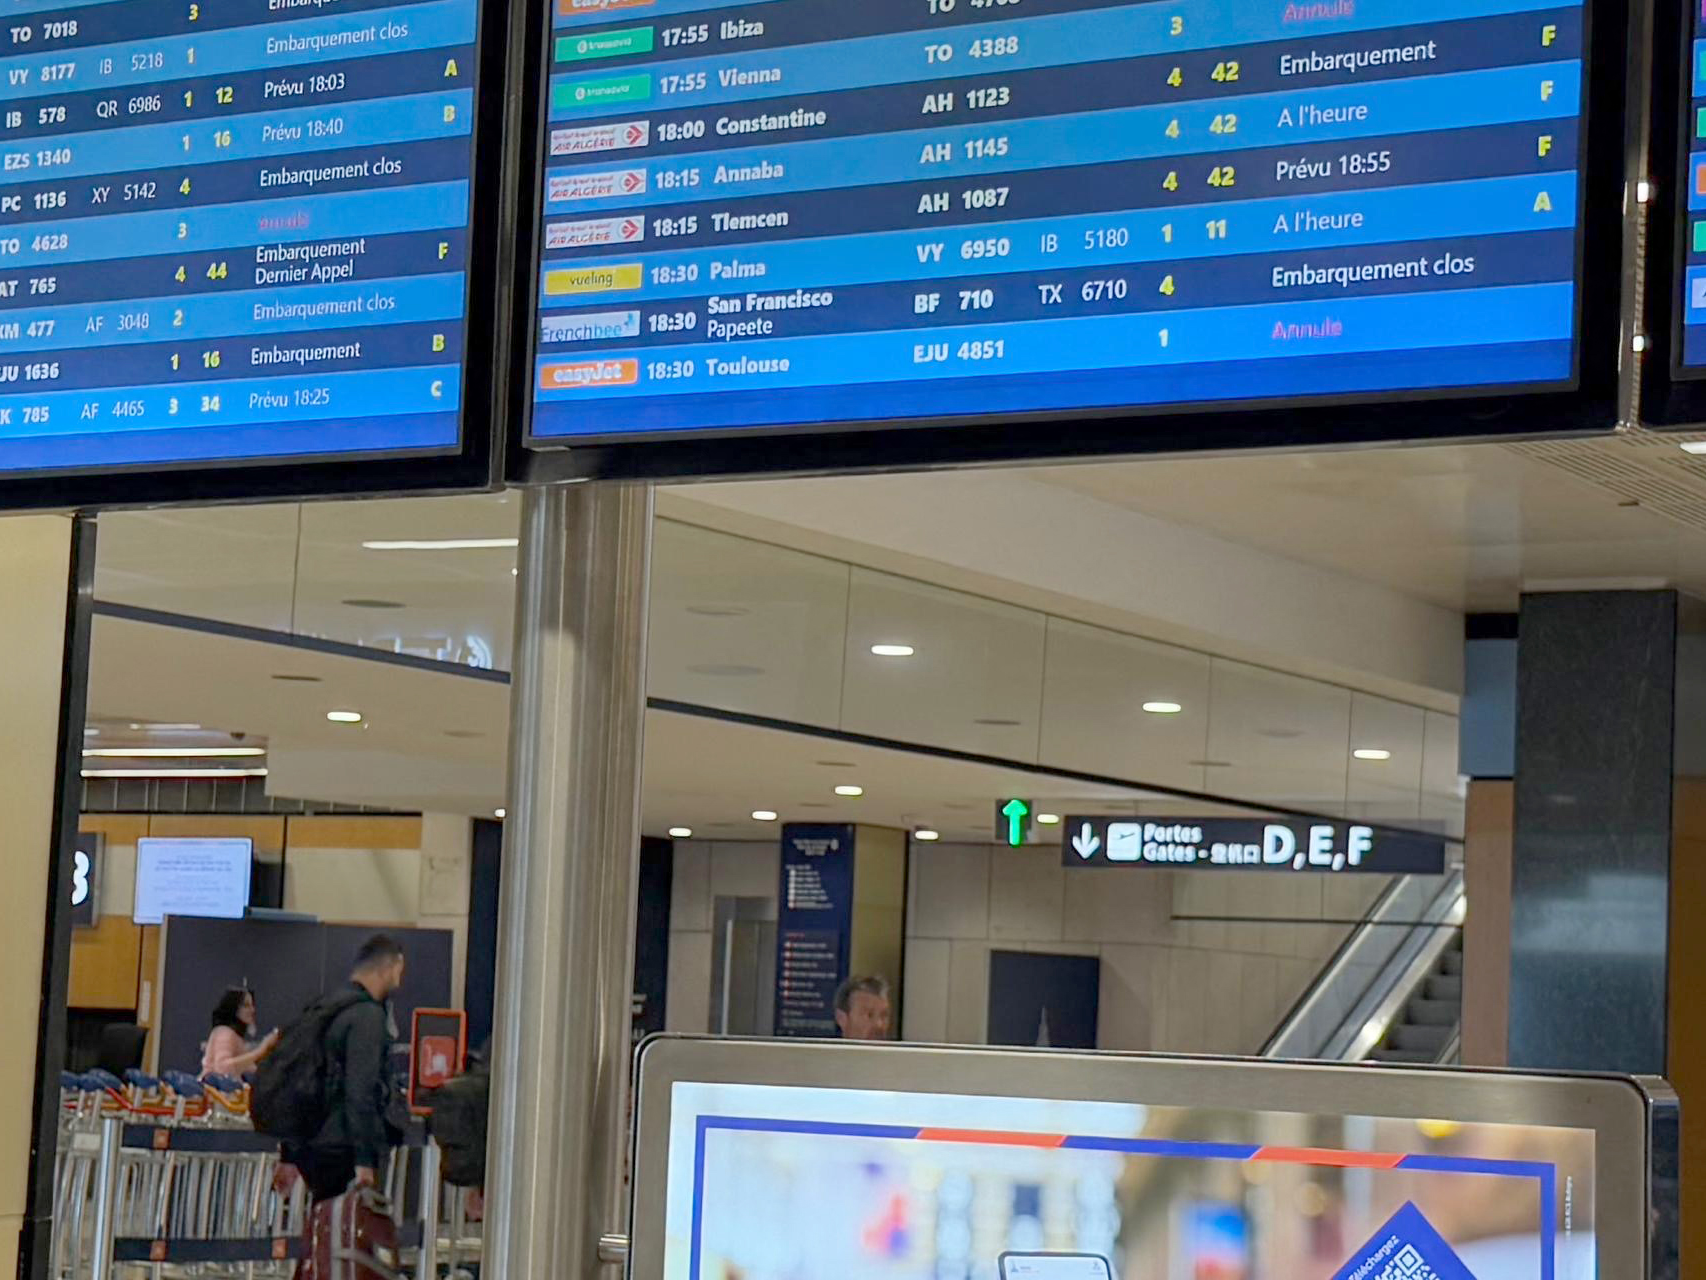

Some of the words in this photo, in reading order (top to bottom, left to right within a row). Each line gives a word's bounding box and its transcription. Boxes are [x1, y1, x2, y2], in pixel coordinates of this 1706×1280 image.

[5, 111, 21, 128] IB
[38, 106, 66, 124] 578
[96, 100, 117, 118] QR
[128, 94, 161, 113] 6986
[215, 86, 233, 104] 12
[264, 79, 304, 98] Prévu
[309, 72, 345, 93] 18:03
[657, 119, 705, 141] 18:00
[715, 108, 826, 135] Constantine
[921, 92, 953, 113] AH
[966, 86, 1010, 108] 1123
[1166, 67, 1182, 87] 4
[1211, 61, 1239, 82] 42
[1280, 40, 1436, 75] Embarquement
[1542, 25, 1556, 46] F
